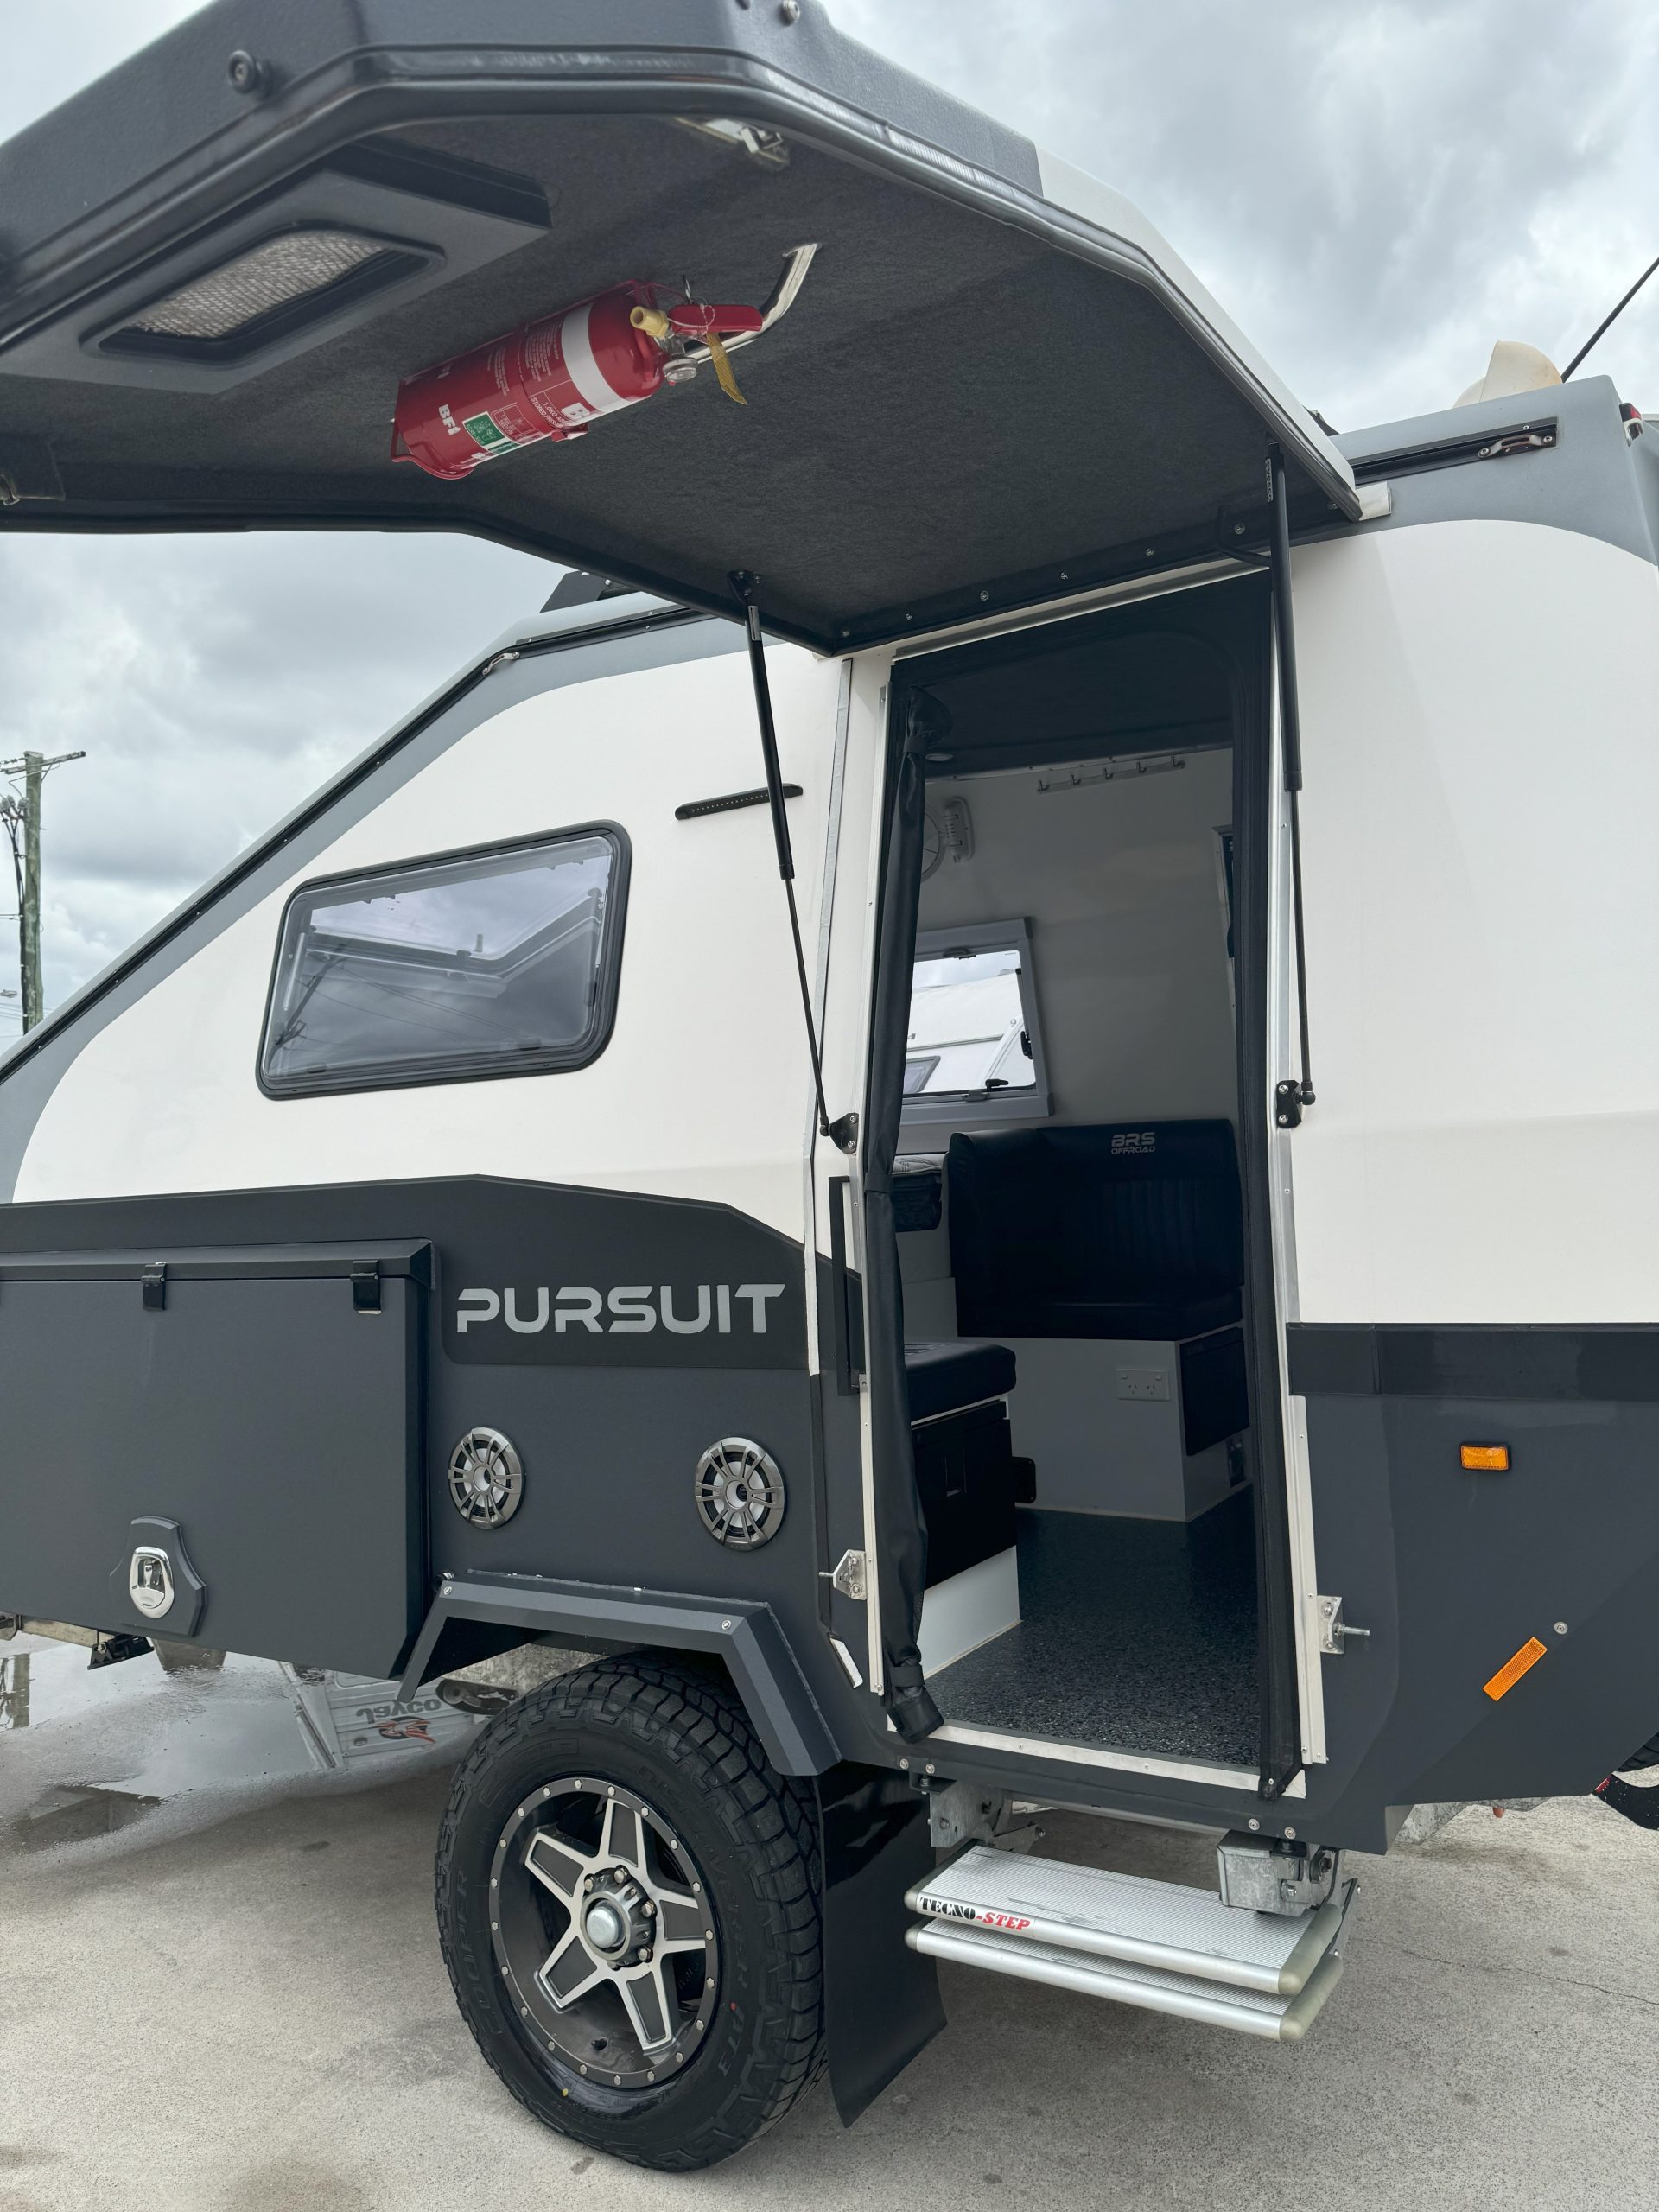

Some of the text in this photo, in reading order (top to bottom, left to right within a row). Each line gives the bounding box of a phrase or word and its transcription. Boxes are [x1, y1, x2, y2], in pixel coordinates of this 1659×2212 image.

[531, 397, 547, 416] STORED
[1111, 1132, 1155, 1147] BRS
[457, 1284, 786, 1334] PURSUIT
[920, 1897, 1031, 1930] TECNO-STEP
[456, 1870, 504, 2035] COOPER
